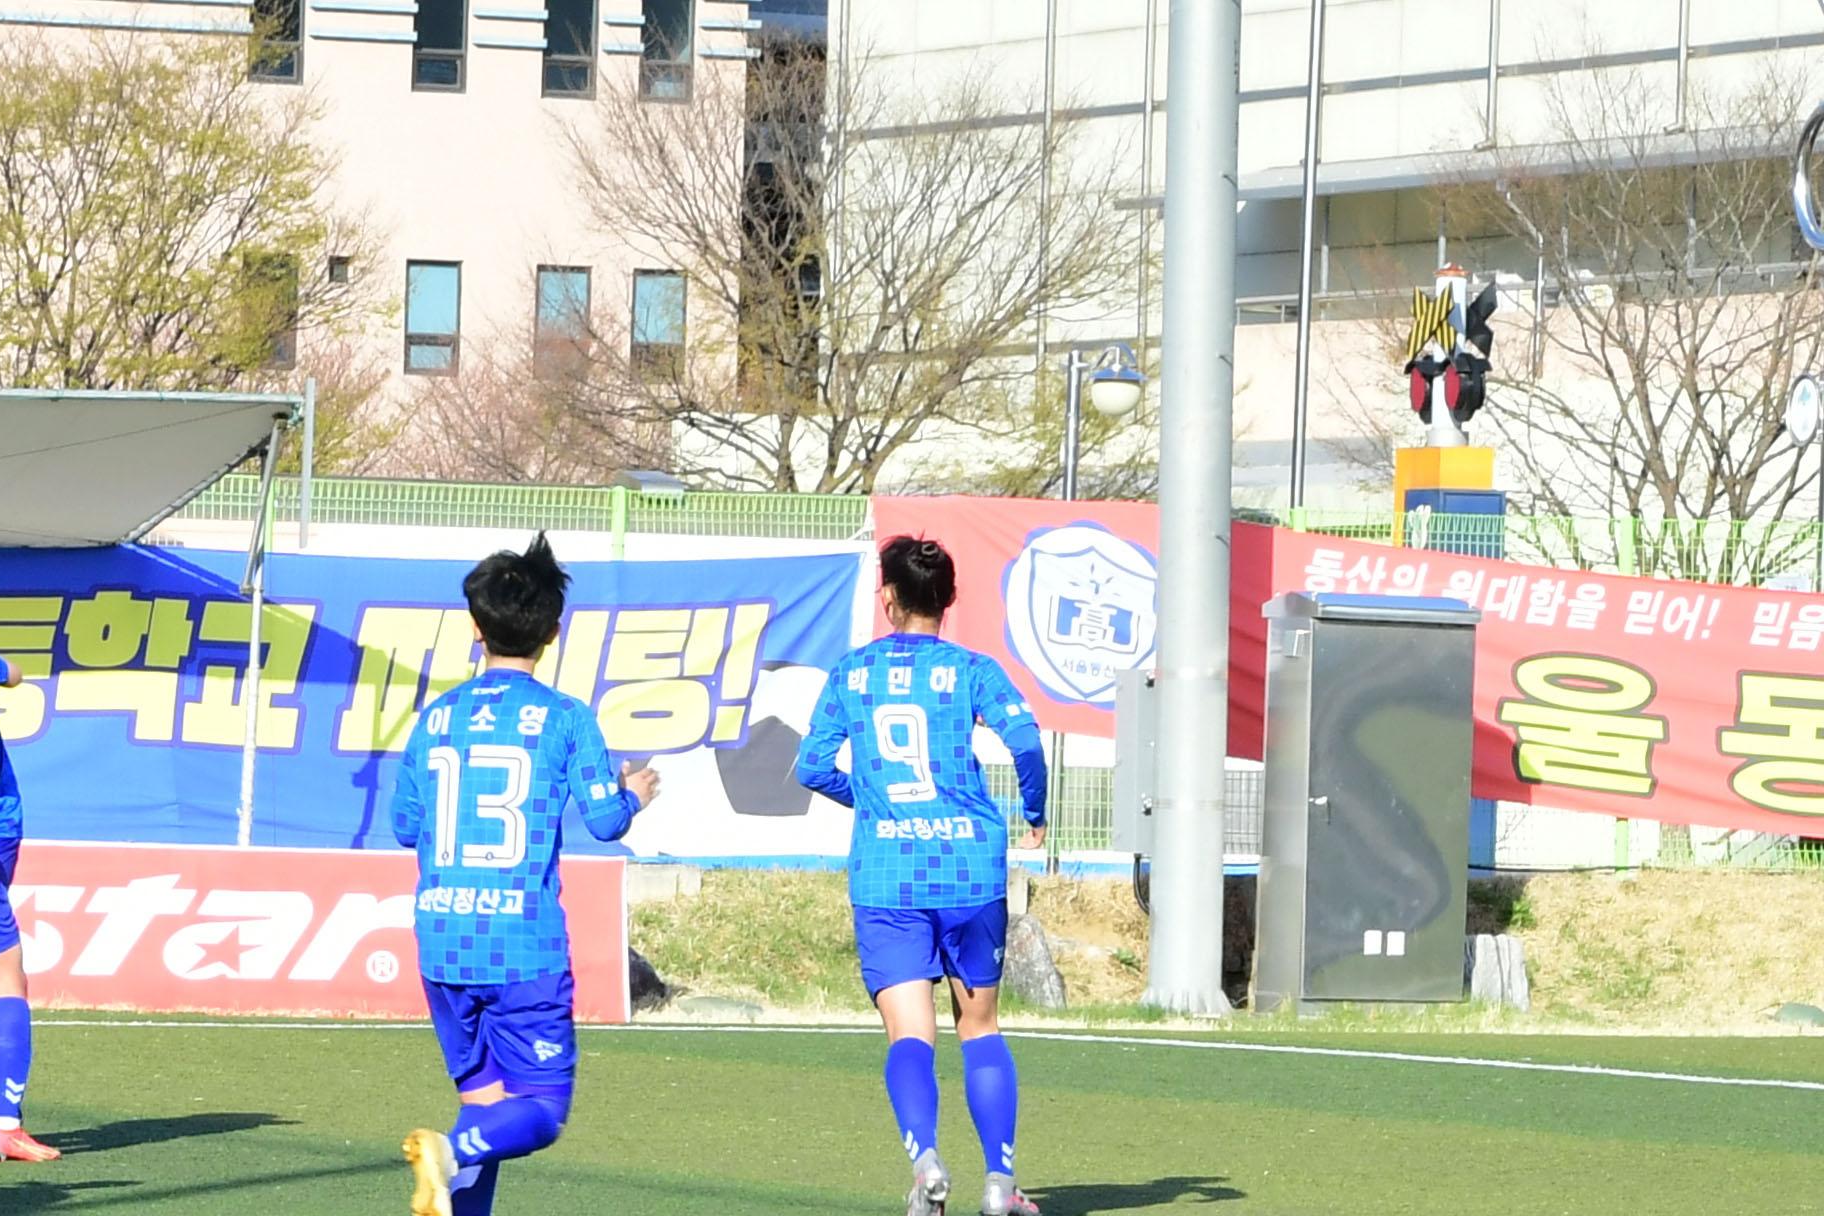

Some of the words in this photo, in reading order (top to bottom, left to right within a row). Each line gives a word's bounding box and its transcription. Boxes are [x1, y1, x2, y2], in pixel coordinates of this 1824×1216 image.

[1622, 589, 1720, 641] 믿어!
[873, 703, 938, 804] 9
[427, 744, 532, 868] 13
